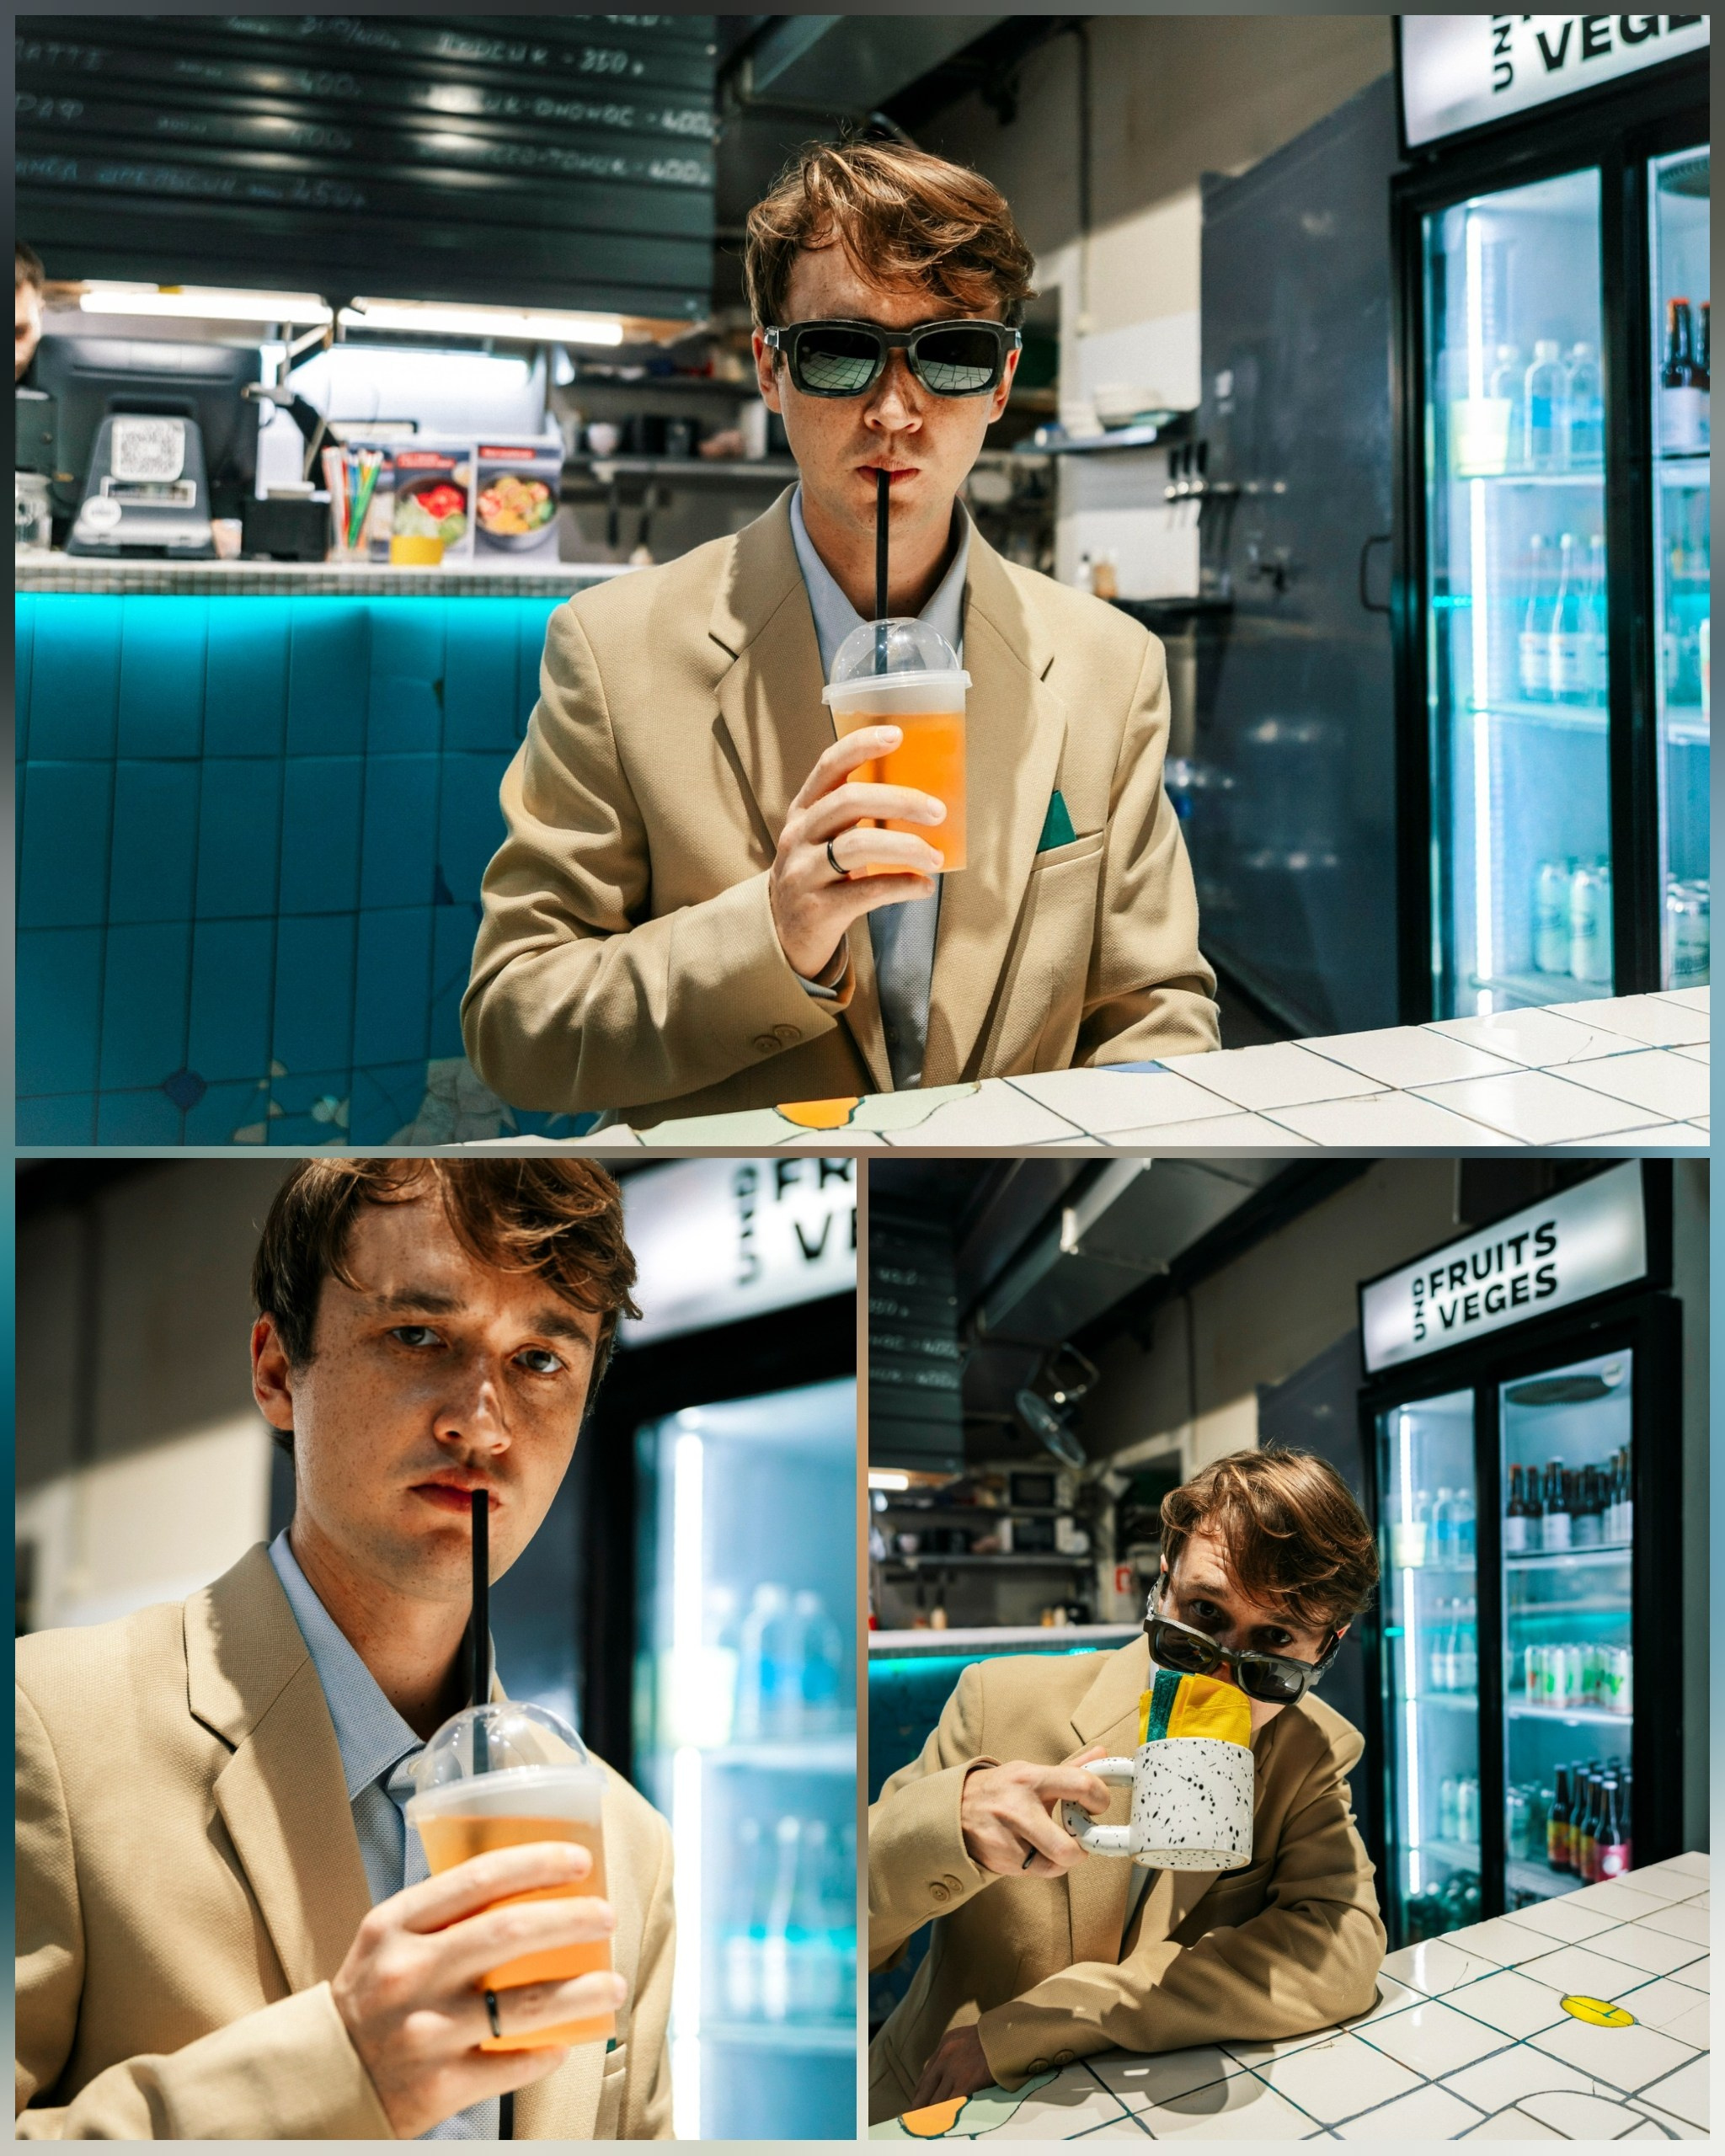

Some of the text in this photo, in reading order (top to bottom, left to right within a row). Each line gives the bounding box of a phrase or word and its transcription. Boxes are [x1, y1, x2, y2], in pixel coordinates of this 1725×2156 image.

[1493, 15, 1514, 93] UN
[793, 1207, 857, 1259] V
[1429, 1221, 1557, 1298] FRUITS
[1413, 1277, 1427, 1342] UND
[1439, 1263, 1558, 1330] VEGES
